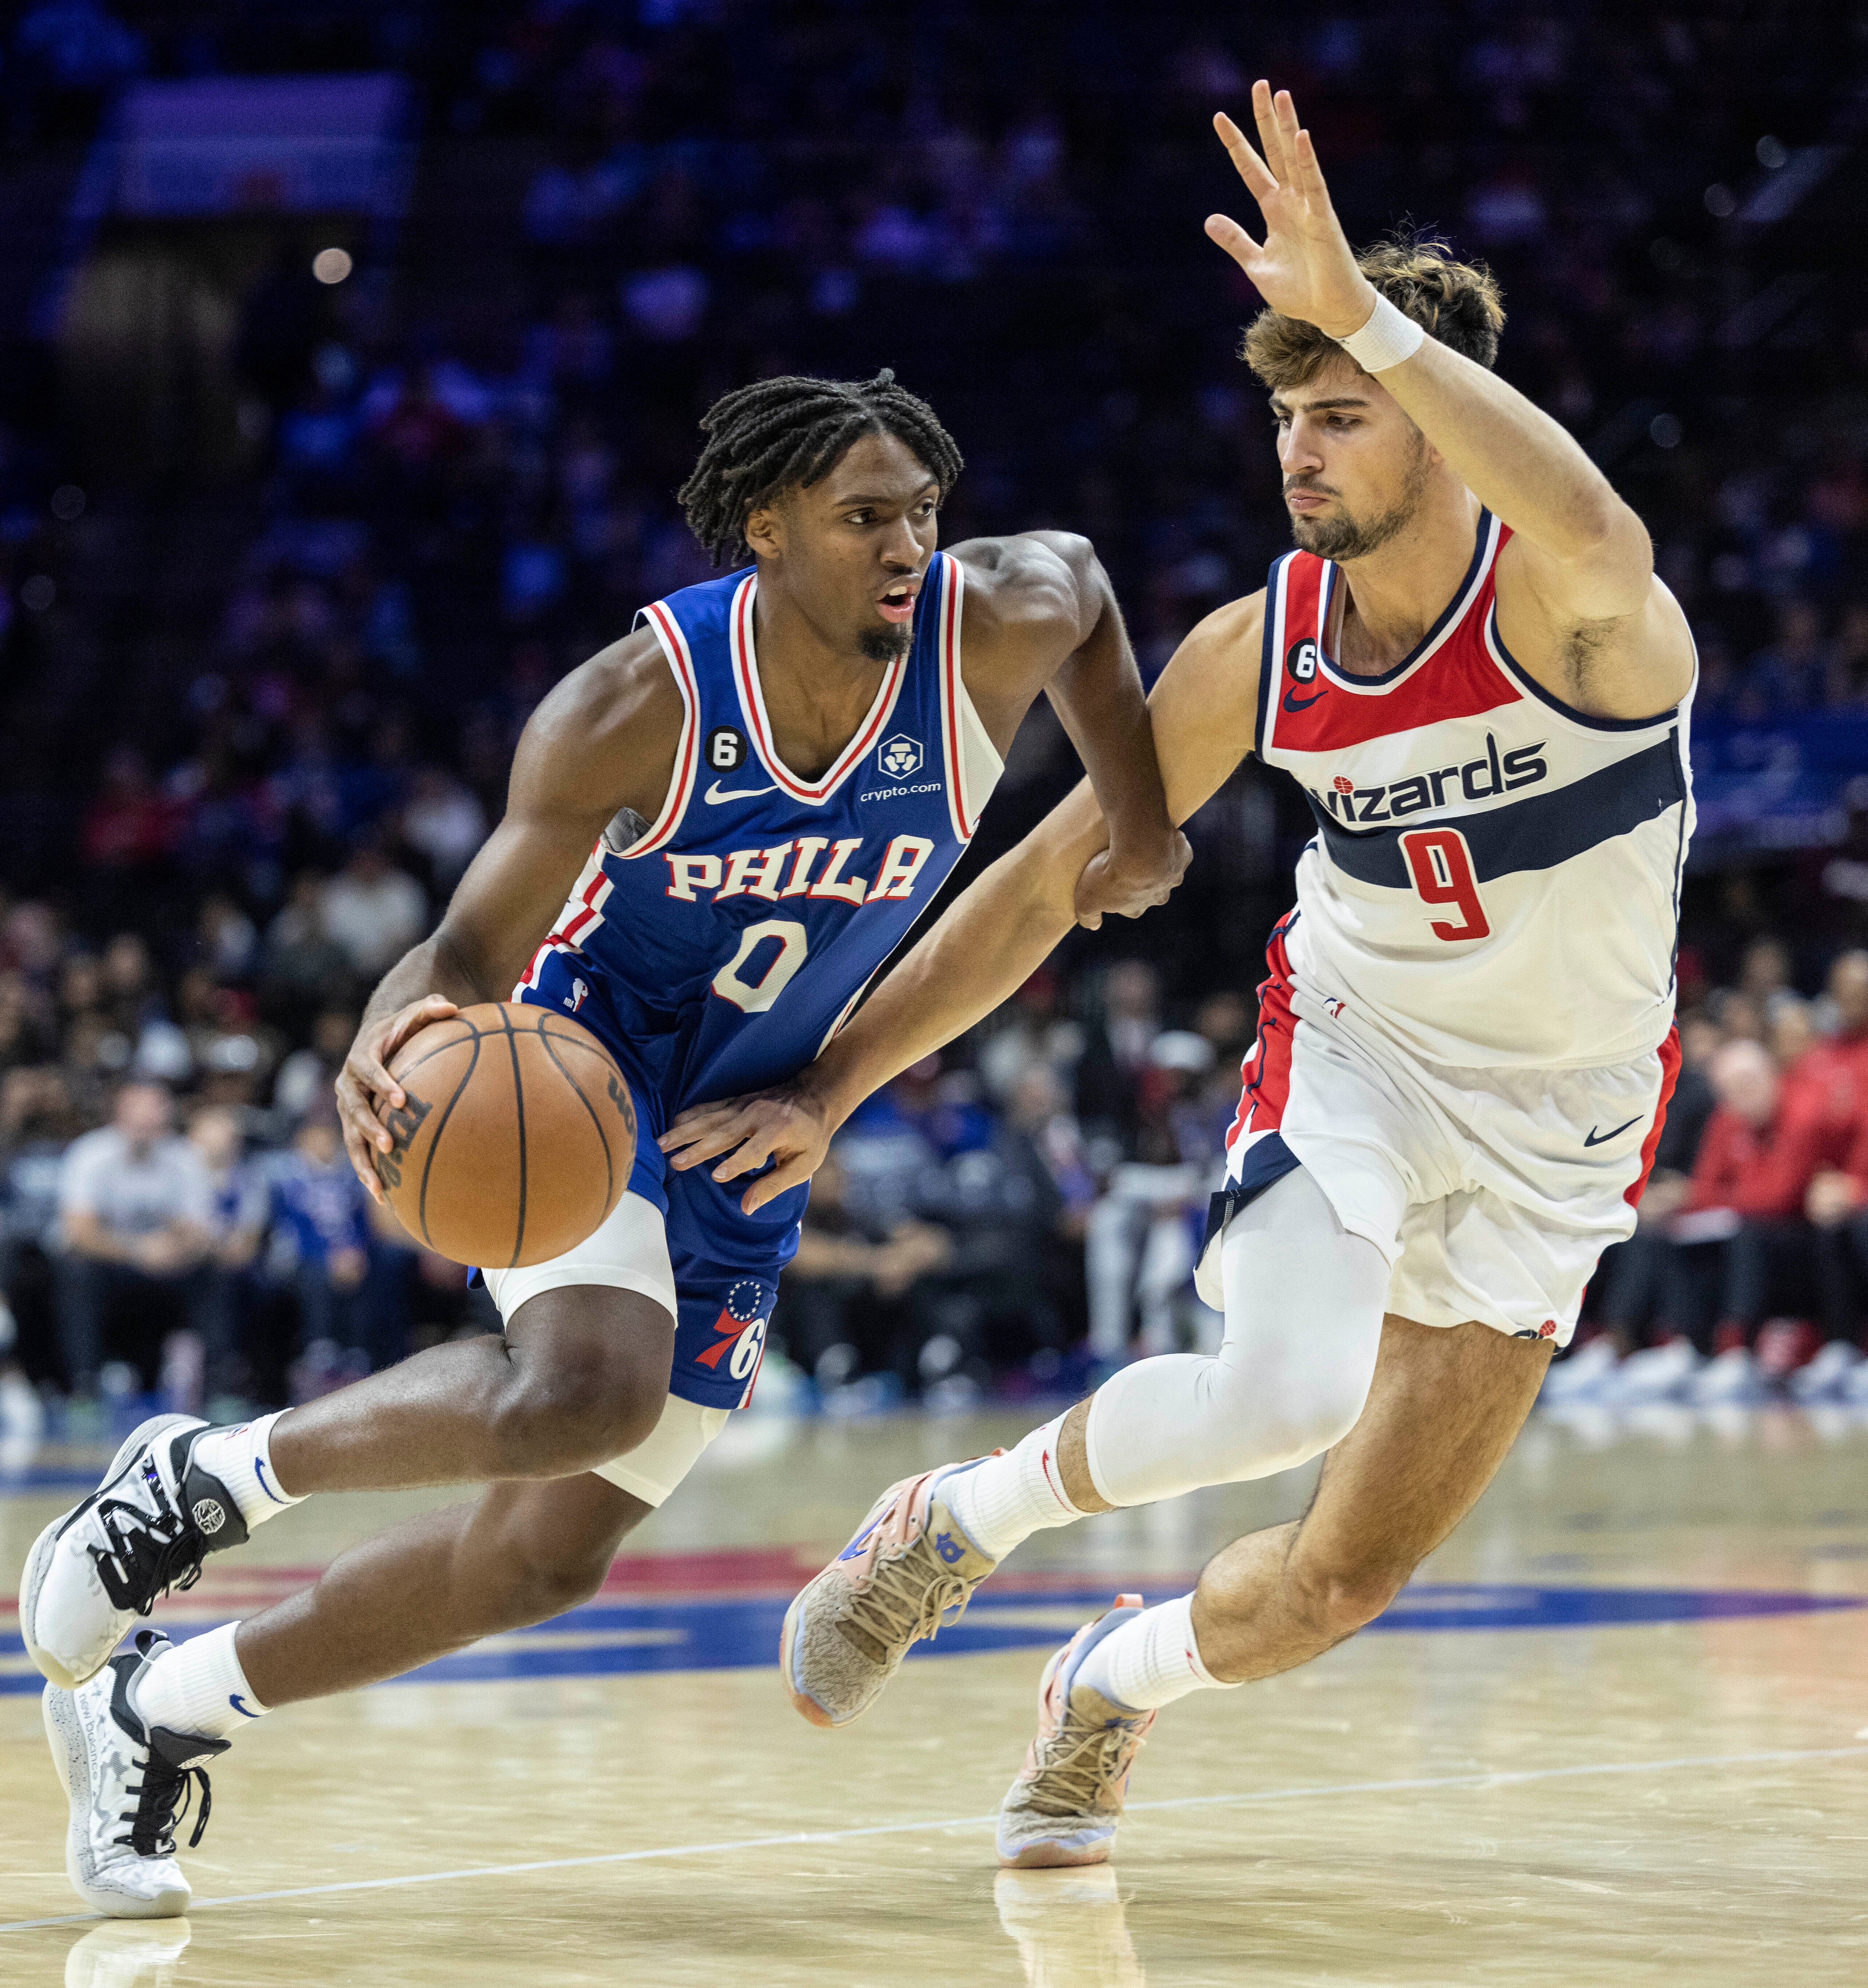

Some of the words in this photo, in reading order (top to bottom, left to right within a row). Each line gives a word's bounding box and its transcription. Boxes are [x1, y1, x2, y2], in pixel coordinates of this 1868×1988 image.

[1296, 644, 1317, 678] 6
[712, 732, 738, 766] 6
[860, 783, 942, 802] crypto.com
[663, 834, 935, 906] PHILA
[1404, 830, 1490, 941] 9
[711, 919, 808, 1013] 0
[563, 997, 574, 1008] NBA
[694, 1307, 765, 1380] 76
[79, 1693, 91, 1719] new
